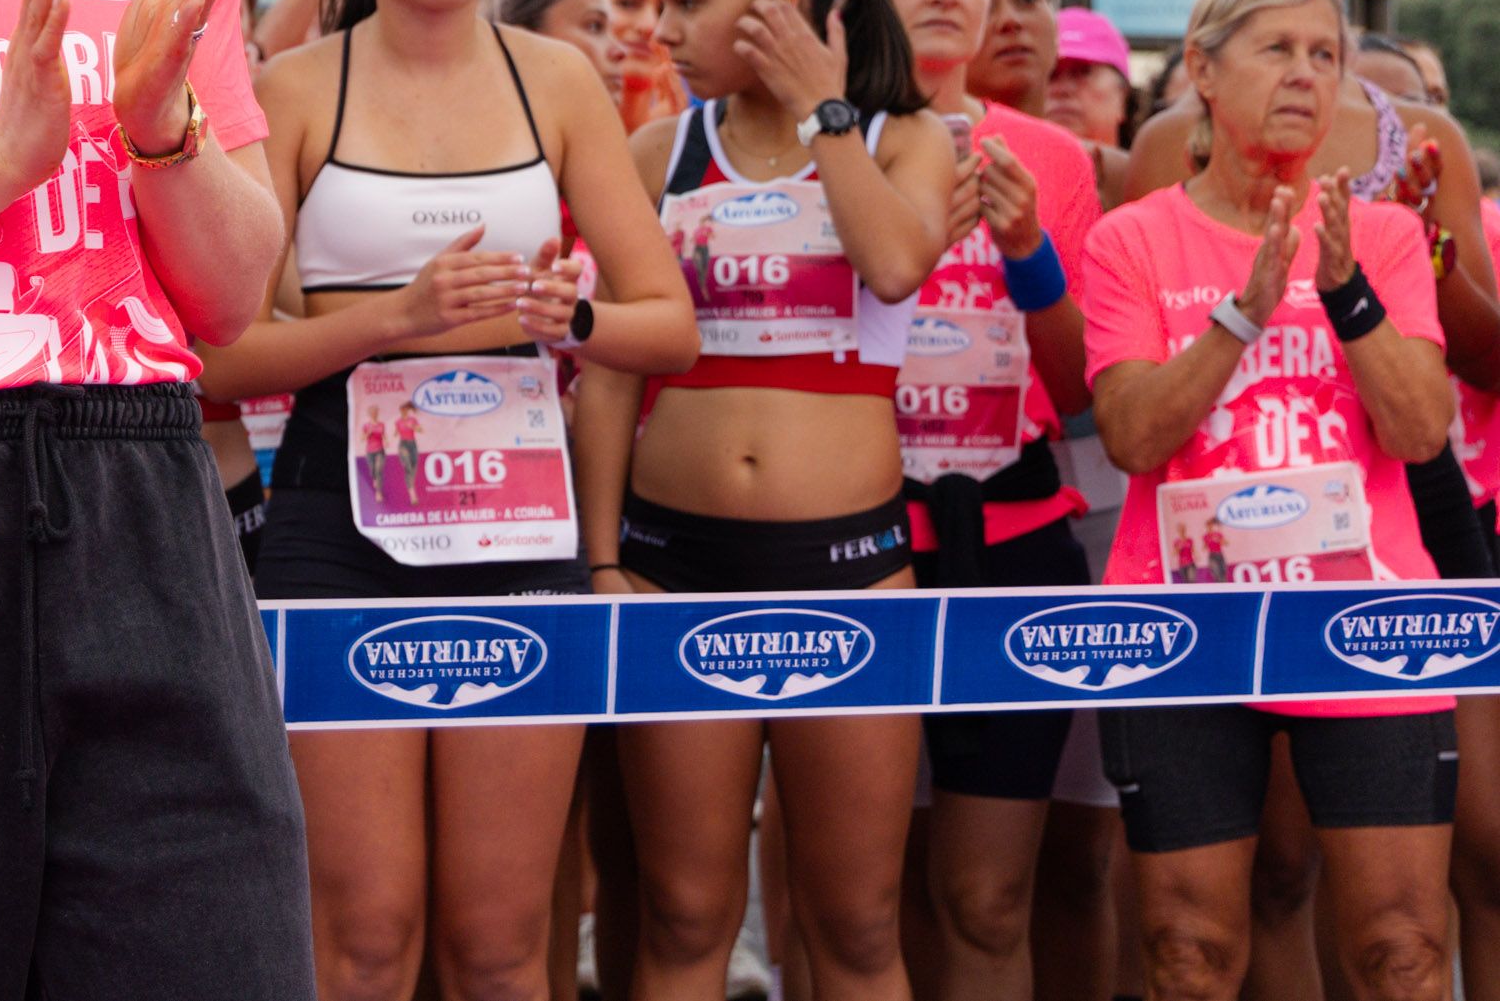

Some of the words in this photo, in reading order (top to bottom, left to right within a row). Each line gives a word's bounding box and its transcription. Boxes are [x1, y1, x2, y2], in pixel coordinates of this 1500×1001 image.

[31, 136, 109, 254] DE
[412, 209, 482, 225] OYSHO
[713, 255, 790, 286] 016
[420, 389, 498, 406] ASTURIANA
[895, 384, 970, 415] 016
[1255, 396, 1315, 468] DE
[424, 450, 507, 485] 016
[458, 491, 477, 505] 21
[375, 511, 425, 526] CARRERA
[427, 511, 443, 524] DE
[444, 510, 457, 523] LA
[459, 508, 495, 522] MUJER
[503, 508, 512, 520] A
[513, 504, 555, 520] CORUÑA
[493, 534, 554, 548] Santander
[1233, 555, 1315, 584] 016
[1340, 612, 1500, 646] ASTURIANA
[1020, 621, 1184, 656] ASTURIANA
[1344, 640, 1404, 652] LECHERA
[1410, 638, 1470, 649] CENTRAL
[363, 638, 533, 674] ASTURIANA
[694, 630, 861, 665] ASTURIANA
[1024, 650, 1087, 662] LECHERA
[1091, 648, 1153, 660] CENTRAL
[700, 659, 762, 670] LECHERA
[768, 657, 830, 668] CENTRAL
[369, 668, 433, 679] LECHERA
[438, 666, 501, 678] CENTRAL
